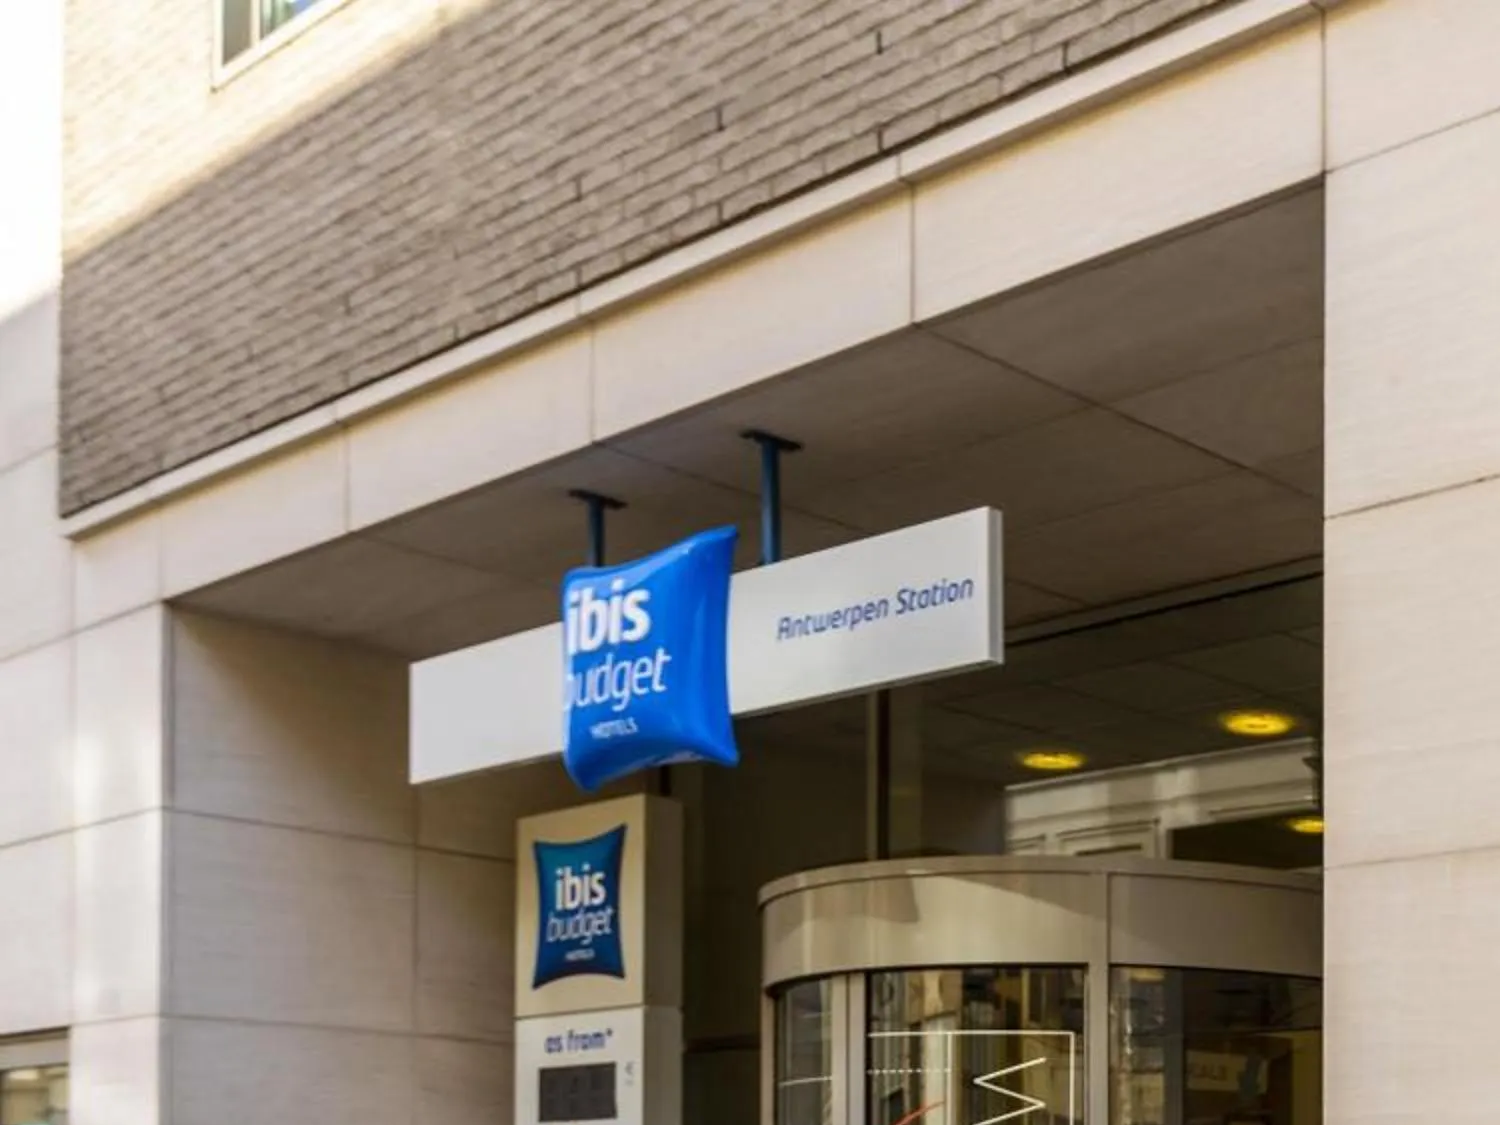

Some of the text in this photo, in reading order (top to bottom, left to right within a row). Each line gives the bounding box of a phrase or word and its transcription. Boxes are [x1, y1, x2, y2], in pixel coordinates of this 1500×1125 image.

[567, 579, 650, 655] ibis
[776, 578, 974, 640] Antwerpen Station
[555, 863, 607, 911] ibis
[546, 907, 614, 945] budget
[544, 1037, 562, 1054] as
